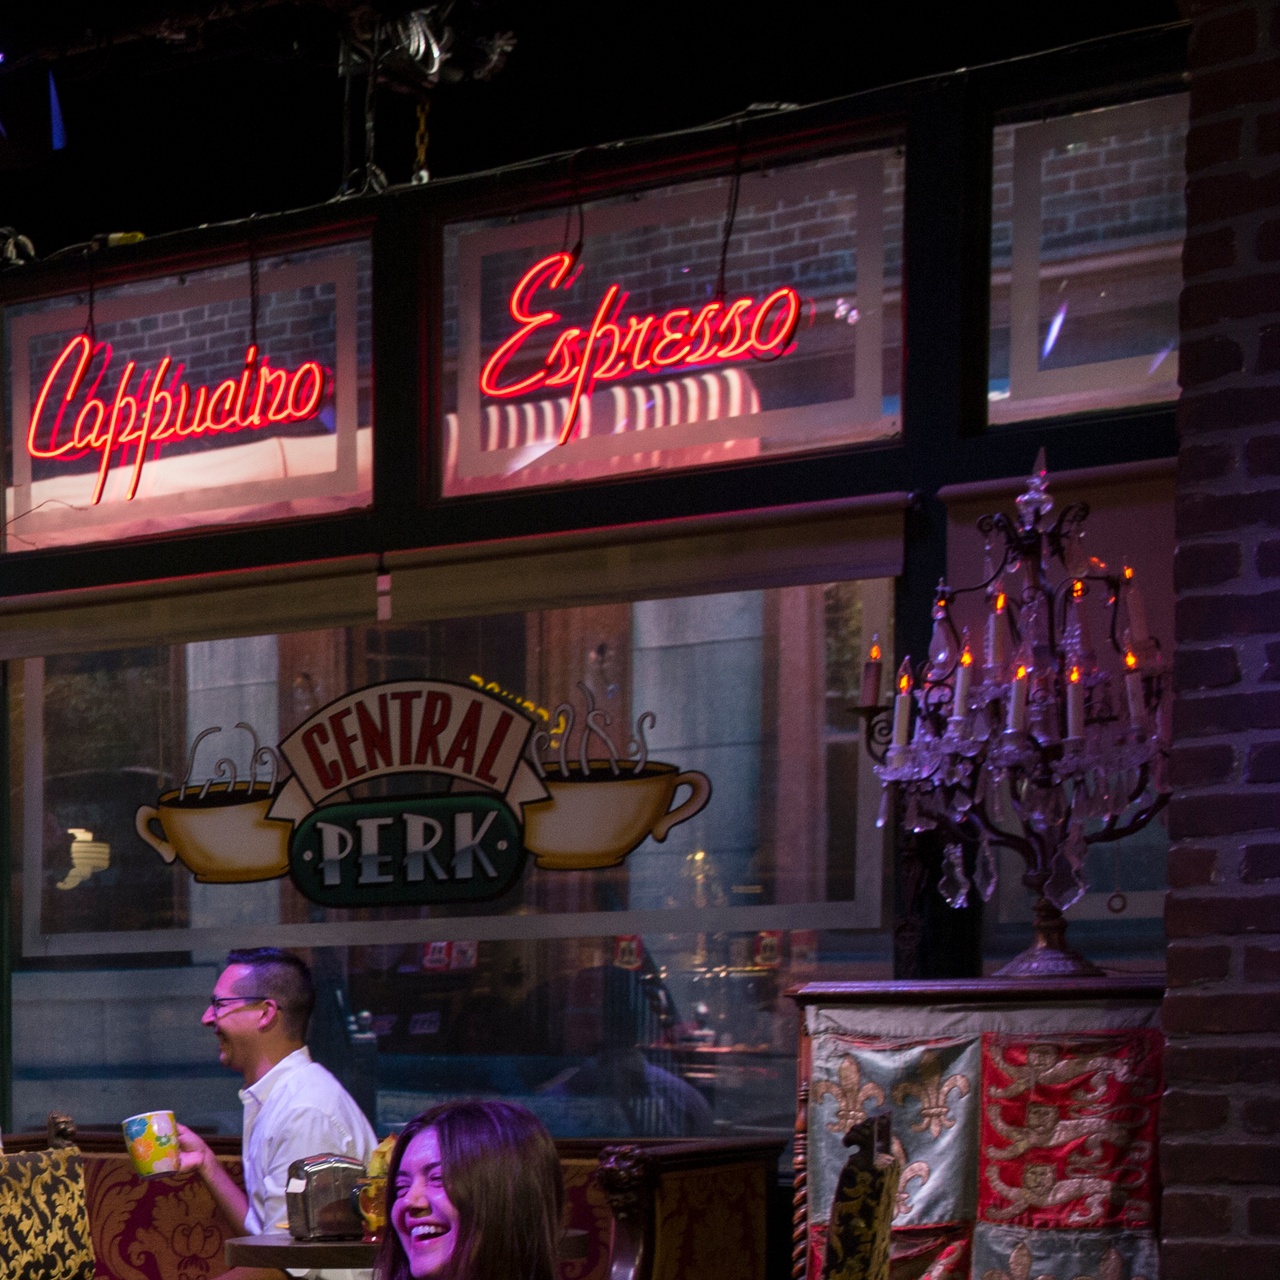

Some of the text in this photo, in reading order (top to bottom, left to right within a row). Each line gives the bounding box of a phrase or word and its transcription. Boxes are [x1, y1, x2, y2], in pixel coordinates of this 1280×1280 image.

[480, 252, 801, 446] Espresso
[27, 333, 324, 505] Cappucino
[301, 690, 514, 790] CENTRAL
[316, 810, 500, 887] PERK
